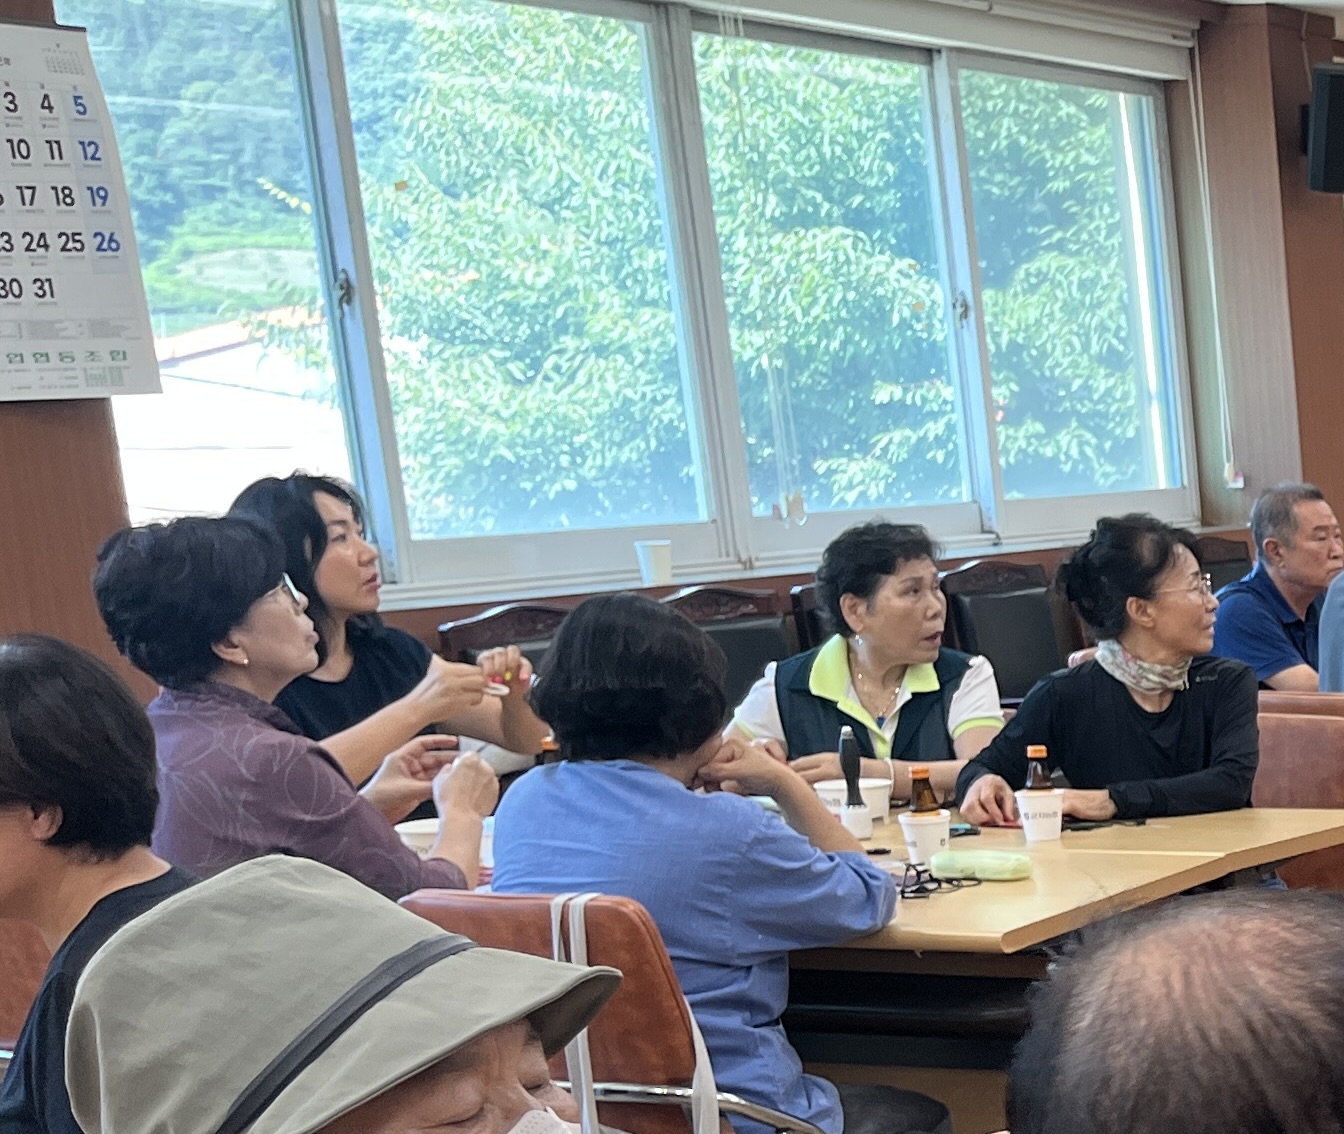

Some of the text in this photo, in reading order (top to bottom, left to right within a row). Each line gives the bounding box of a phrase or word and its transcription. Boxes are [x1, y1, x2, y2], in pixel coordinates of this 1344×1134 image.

[3, 91, 87, 116] 3 4 5
[6, 138, 102, 161] 10 11 12
[16, 185, 108, 208] 17 18 19
[21, 231, 50, 253] 24
[57, 231, 85, 253] 25
[93, 231, 120, 253] 26
[32, 277, 55, 299] 31
